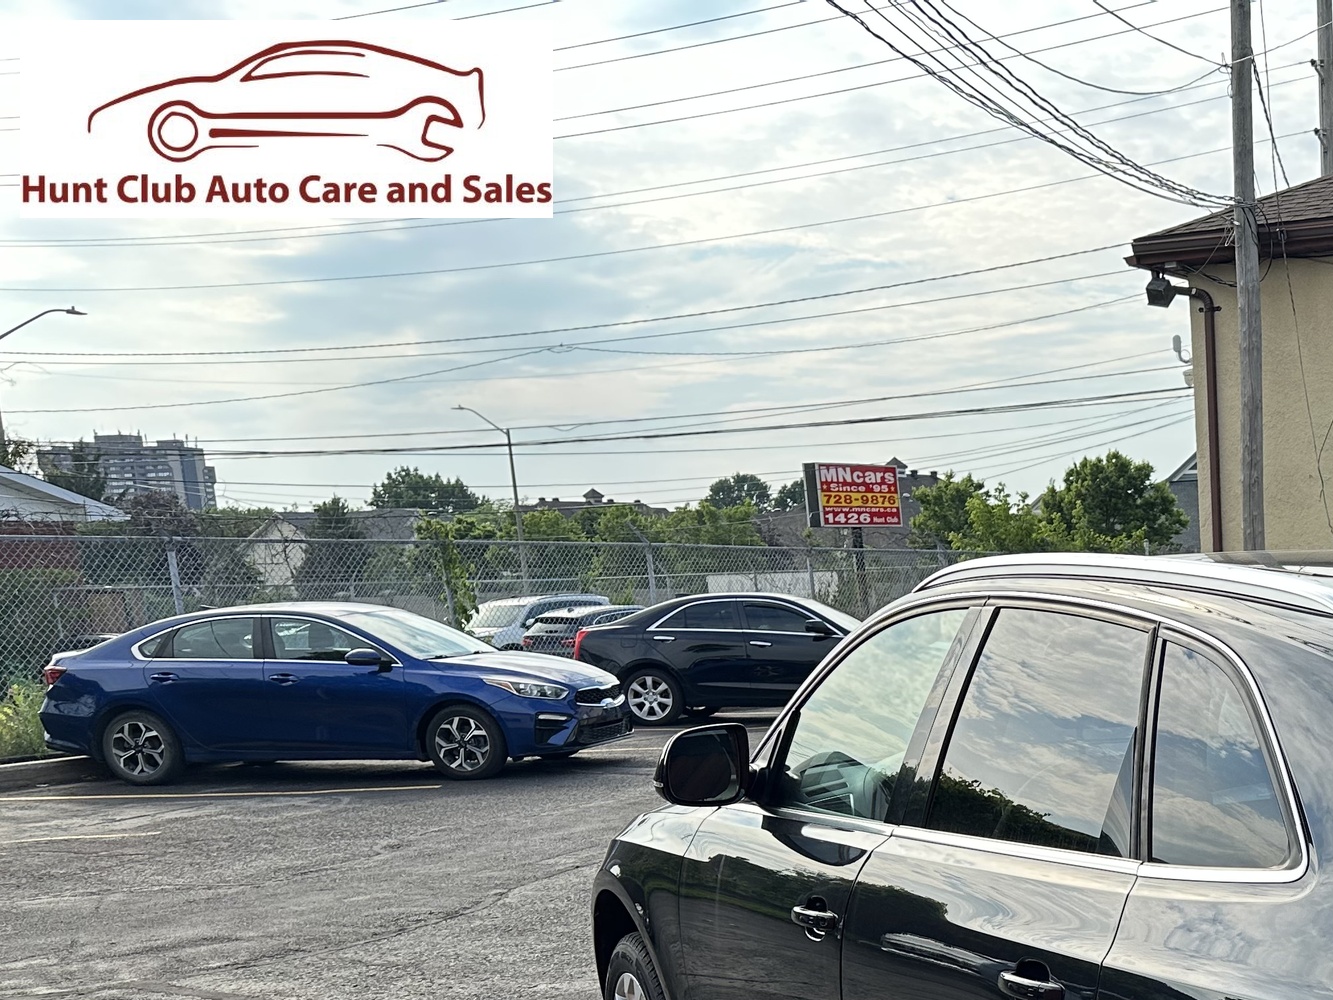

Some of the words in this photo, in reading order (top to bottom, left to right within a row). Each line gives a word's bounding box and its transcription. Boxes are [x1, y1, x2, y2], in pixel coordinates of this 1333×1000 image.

[820, 466, 895, 484] MNcars
[829, 483, 866, 492] Since
[823, 494, 896, 506] 728-9876
[825, 513, 871, 523] 1426
[886, 515, 899, 523] Club
